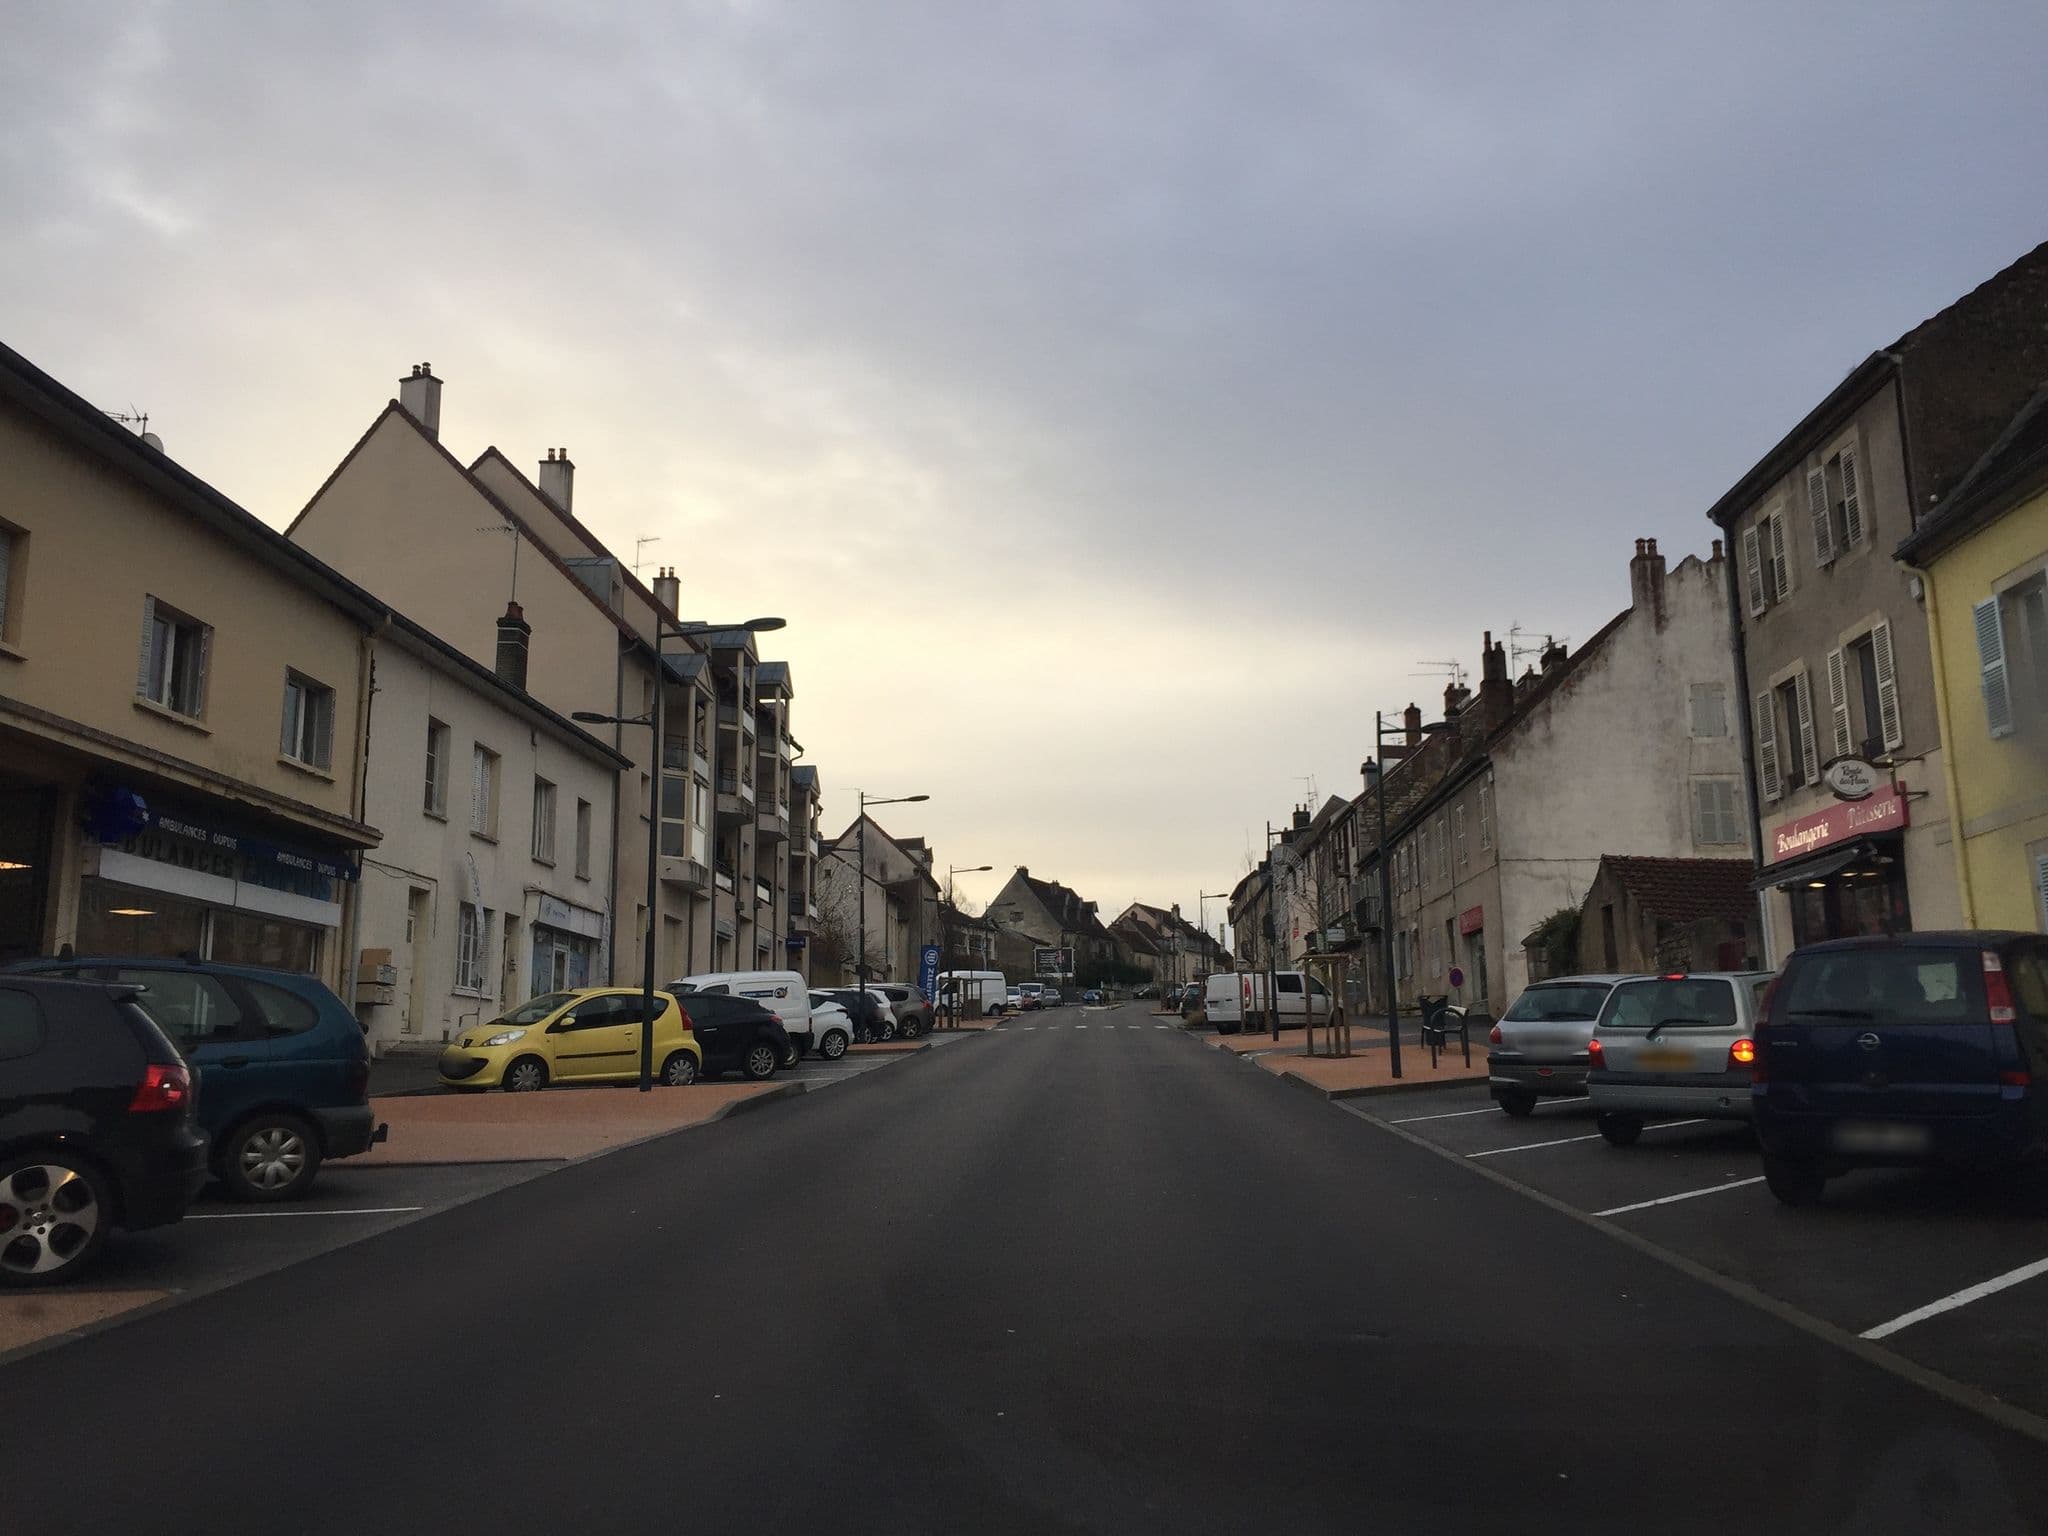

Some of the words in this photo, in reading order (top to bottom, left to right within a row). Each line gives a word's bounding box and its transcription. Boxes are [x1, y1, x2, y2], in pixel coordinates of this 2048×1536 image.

[158, 816, 207, 841] AMBULANCES
[1776, 819, 1829, 852] Boulangerie
[276, 851, 312, 871] AMBULANCES
